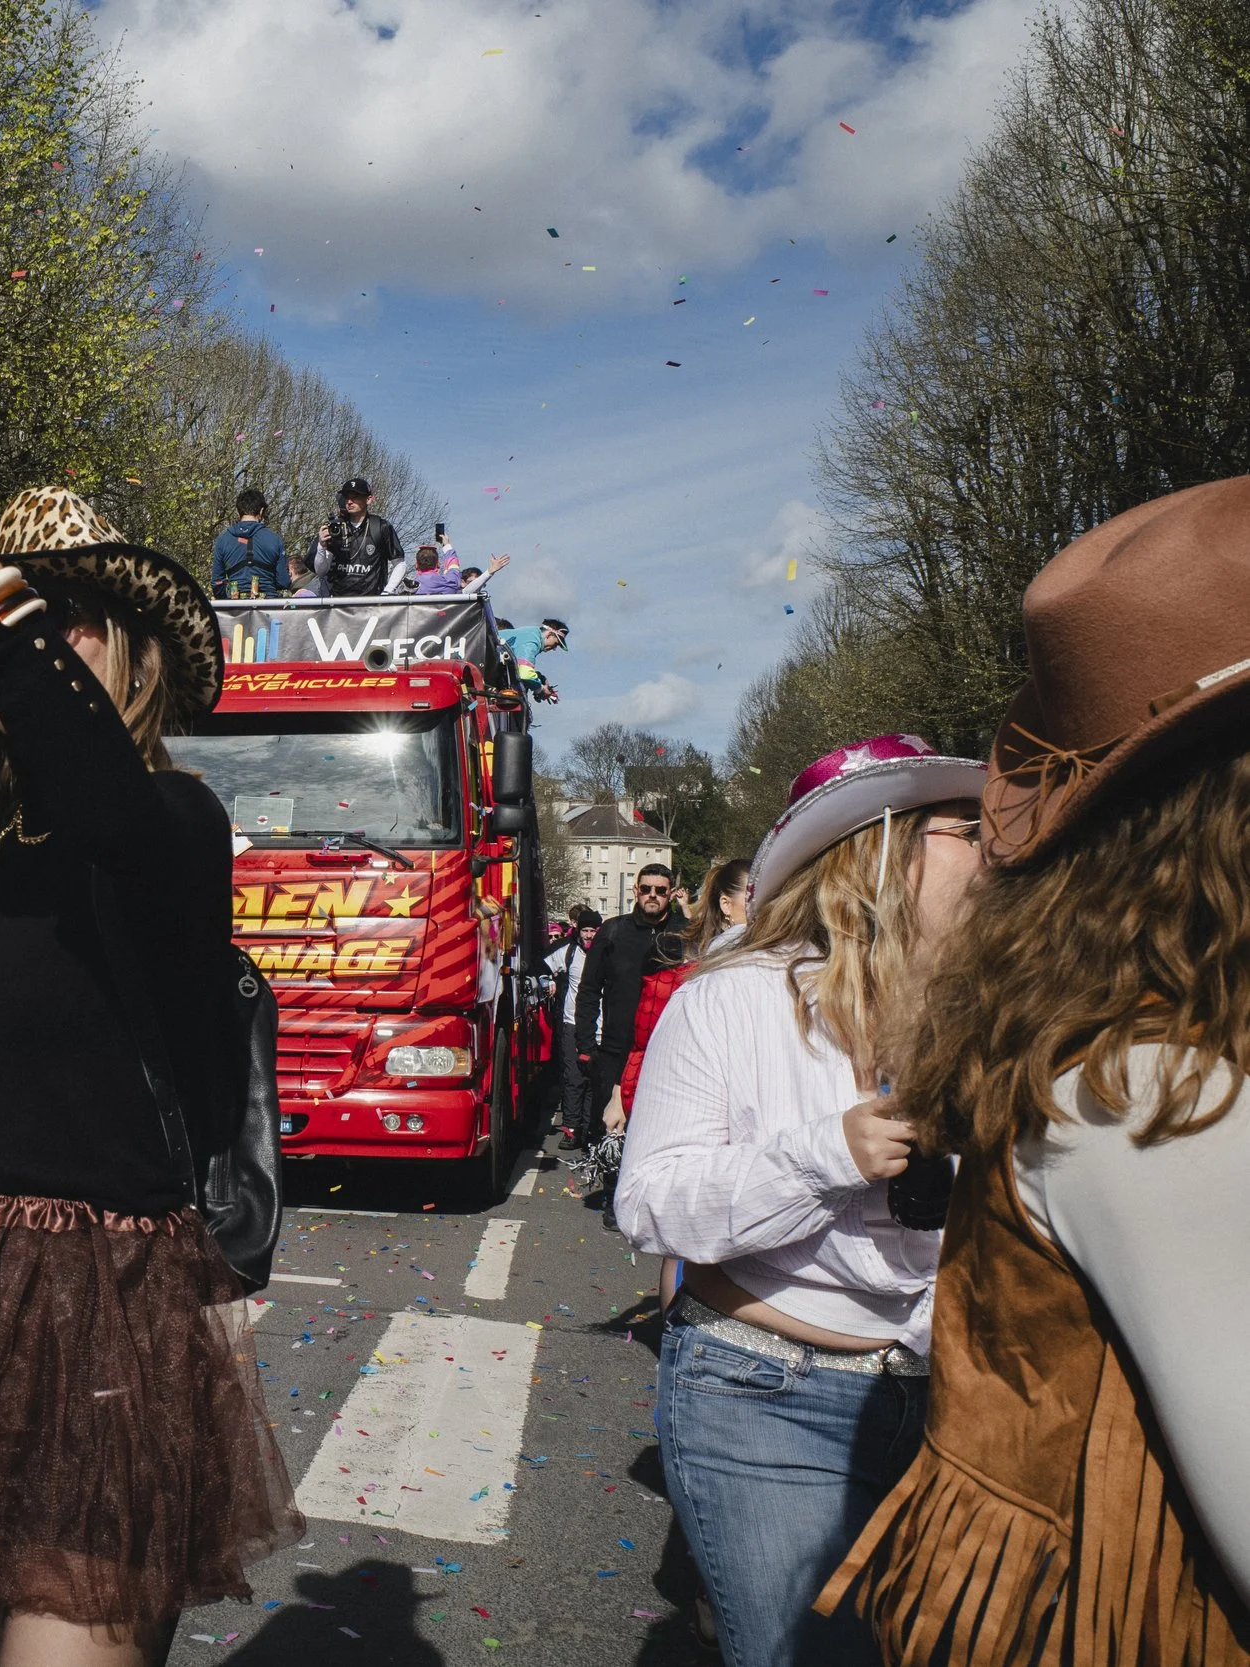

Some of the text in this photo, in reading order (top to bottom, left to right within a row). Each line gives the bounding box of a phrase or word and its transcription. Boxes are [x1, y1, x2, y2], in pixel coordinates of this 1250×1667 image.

[247, 677, 398, 692] VEHICULES
[242, 937, 415, 979] NAGE
[283, 1121, 290, 1129] 14
